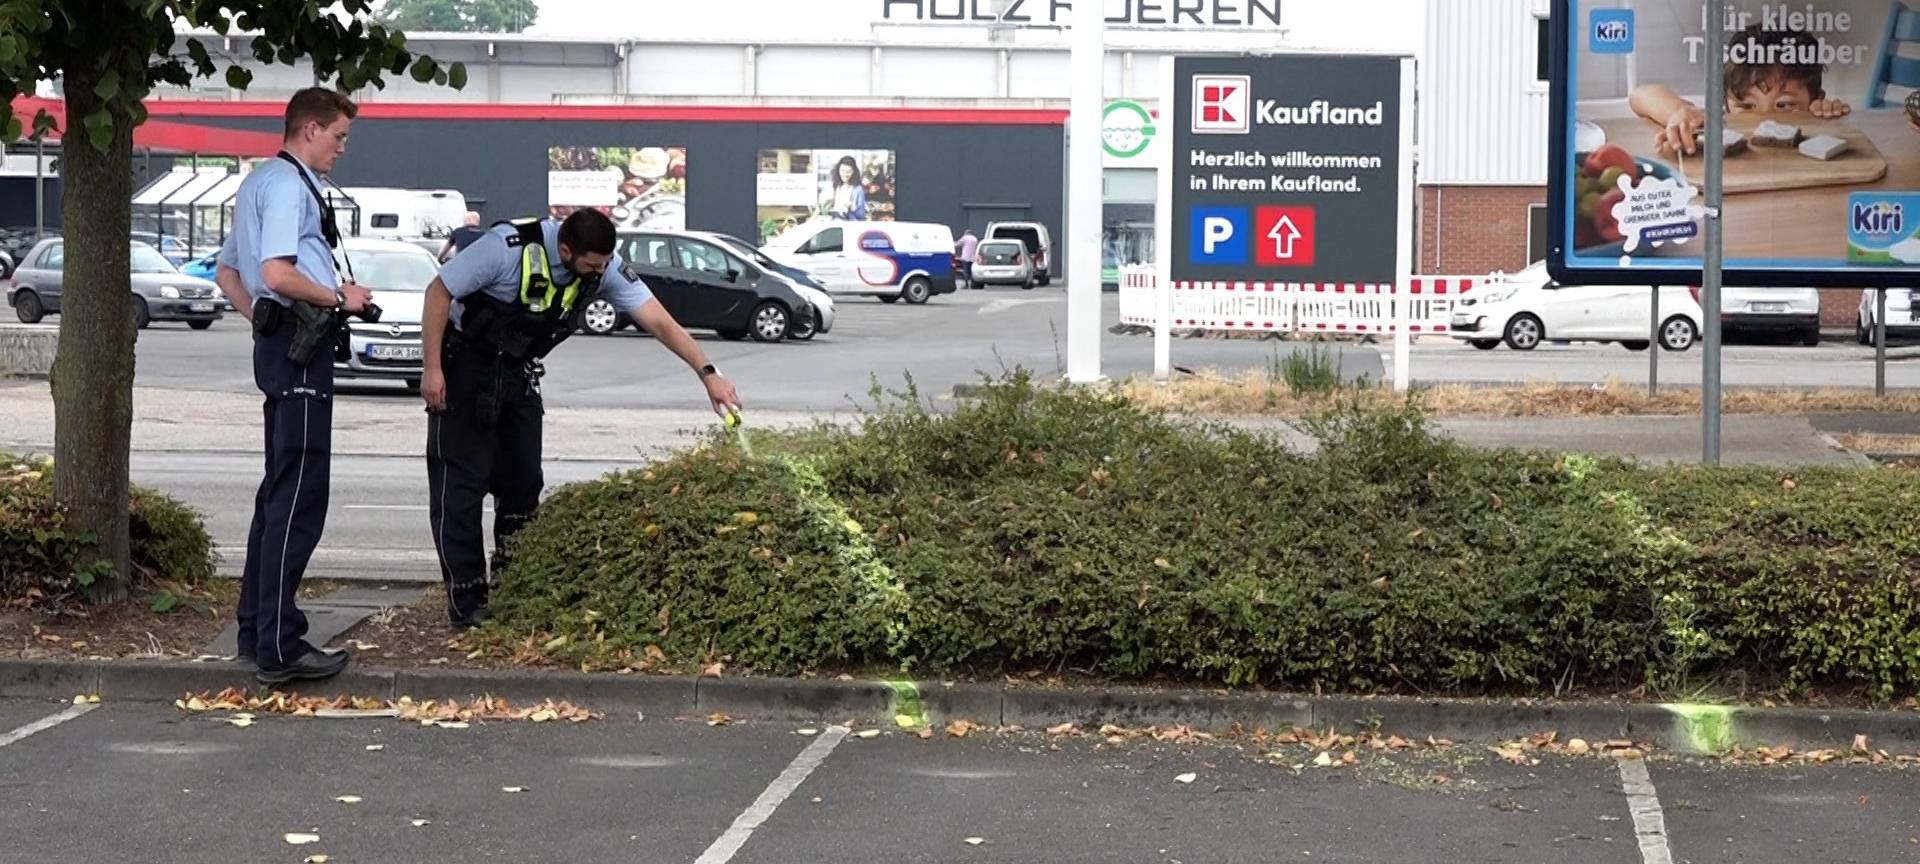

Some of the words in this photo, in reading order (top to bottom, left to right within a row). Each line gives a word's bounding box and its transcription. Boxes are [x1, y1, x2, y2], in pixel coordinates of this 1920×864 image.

[1597, 22, 1626, 40] Kiri
[1762, 4, 1852, 32] kleine
[1682, 36, 1868, 64] Tchräuber
[1256, 99, 1383, 125] Kaufland
[1190, 150, 1266, 167] Herzlich
[1271, 151, 1382, 168] willkommen
[1190, 175, 1207, 190] in
[1212, 174, 1266, 190] Ihrem
[1271, 175, 1362, 192] Kaufland.
[1854, 203, 1902, 232] Kiri
[1203, 216, 1234, 254] P
